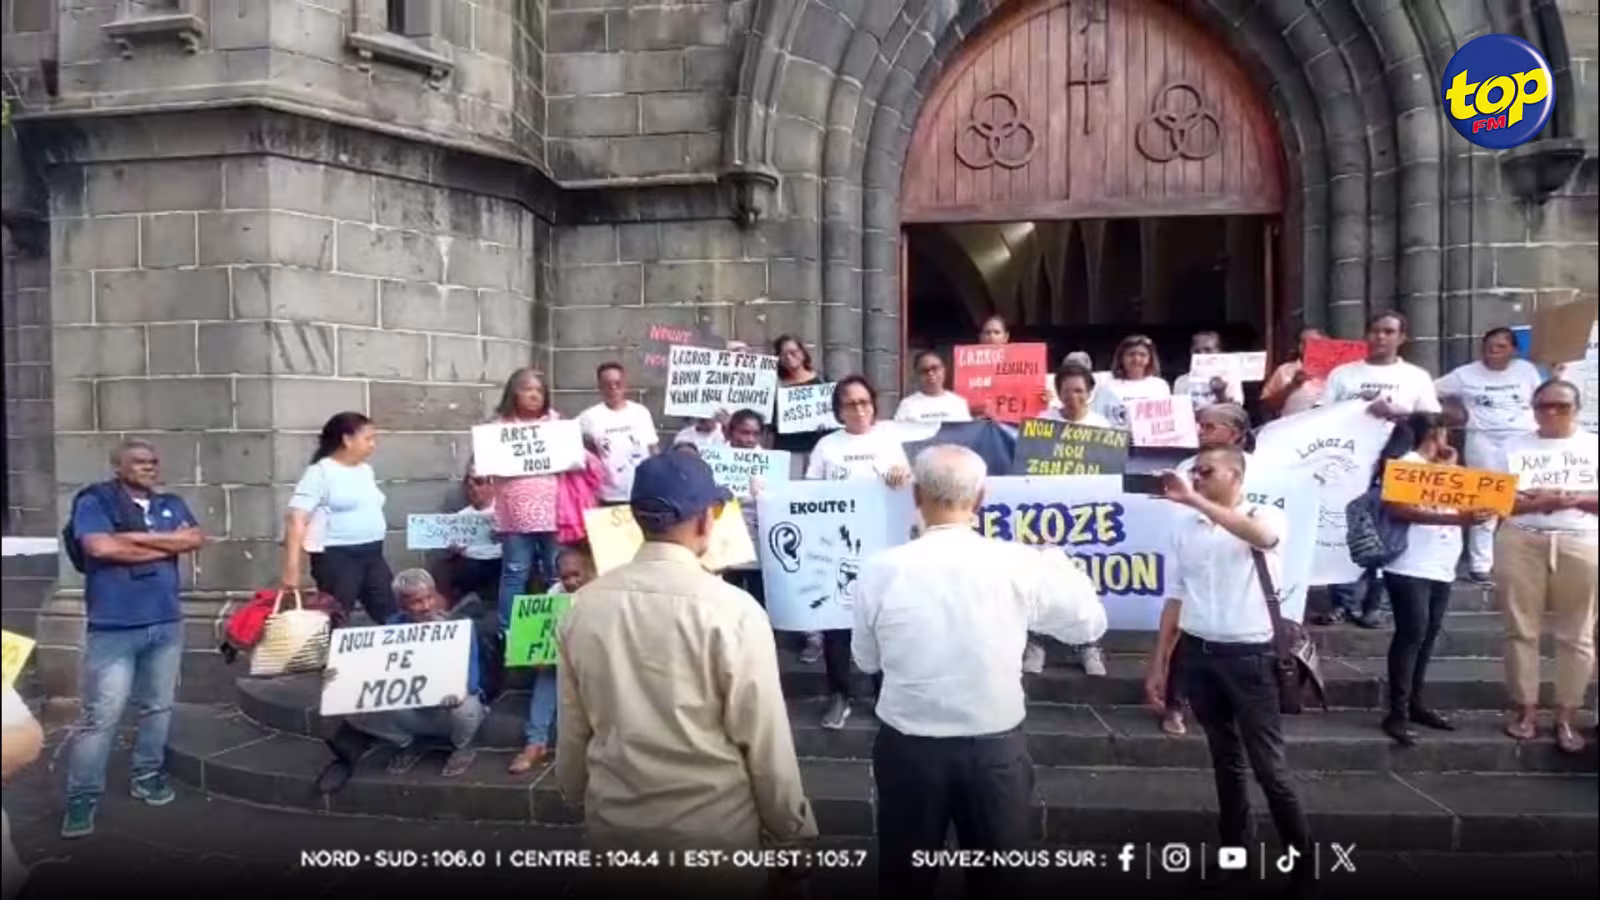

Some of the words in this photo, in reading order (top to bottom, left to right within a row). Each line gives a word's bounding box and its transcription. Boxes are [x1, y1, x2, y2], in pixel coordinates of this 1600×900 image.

[717, 352, 731, 366] PE
[735, 353, 757, 369] FER
[500, 425, 541, 443] ARET
[1024, 420, 1055, 438] NOU
[1060, 423, 1128, 448] KONTAN
[1053, 442, 1085, 459] NOU
[1477, 476, 1506, 493] PE
[1015, 502, 1127, 546] KOZE
[518, 597, 553, 619] NOU
[338, 632, 376, 654] NOU
[382, 624, 458, 645] ZANFAN
[385, 650, 414, 671] PE
[355, 675, 428, 709] MOR
